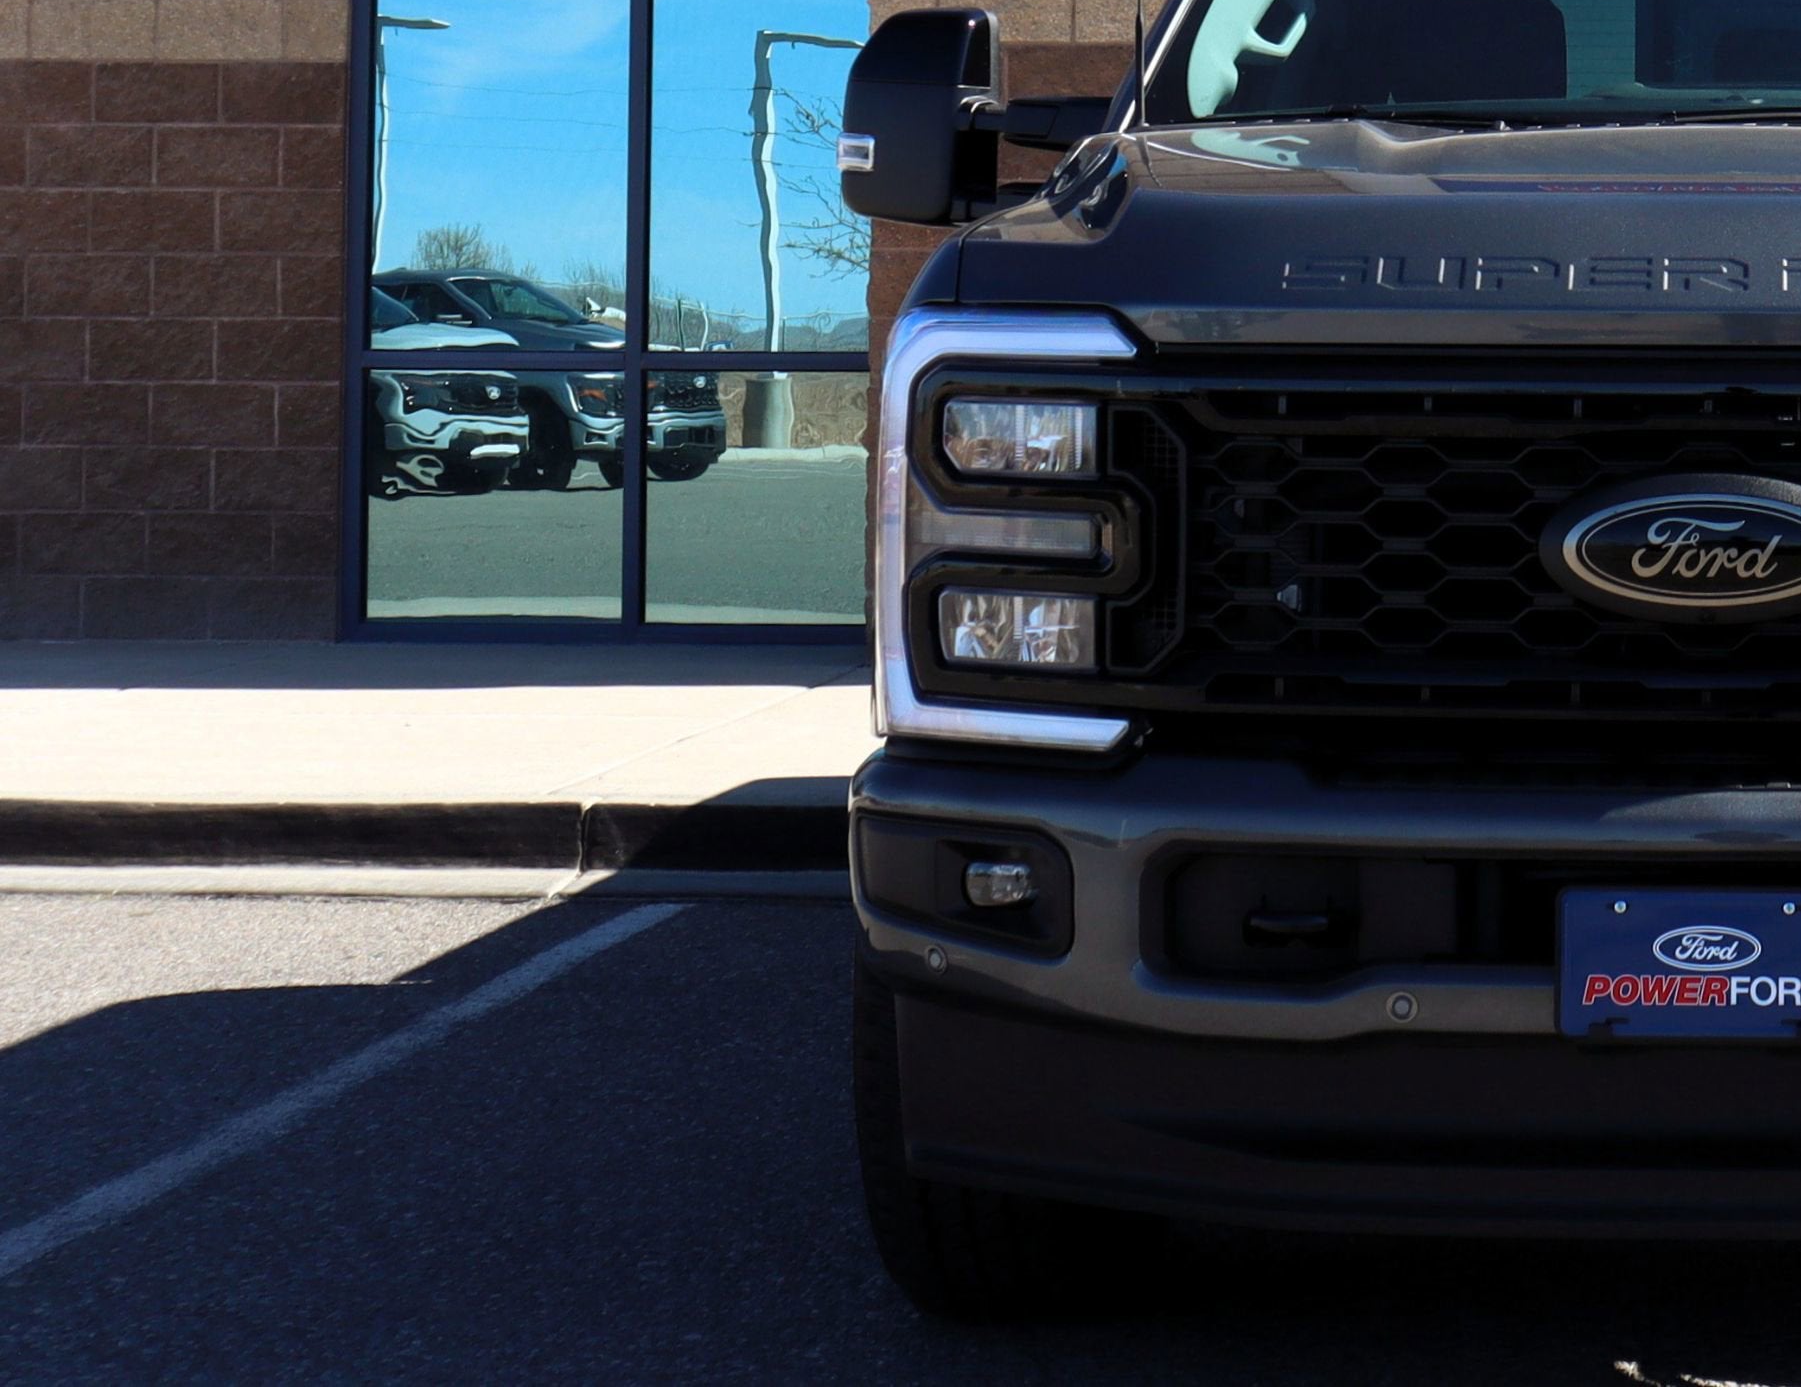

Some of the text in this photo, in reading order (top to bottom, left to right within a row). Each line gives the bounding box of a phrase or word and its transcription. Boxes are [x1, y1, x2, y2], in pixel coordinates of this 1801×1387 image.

[1282, 255, 1750, 293] SUPER
[1631, 517, 1782, 578] Ford
[1675, 933, 1738, 961] Ford
